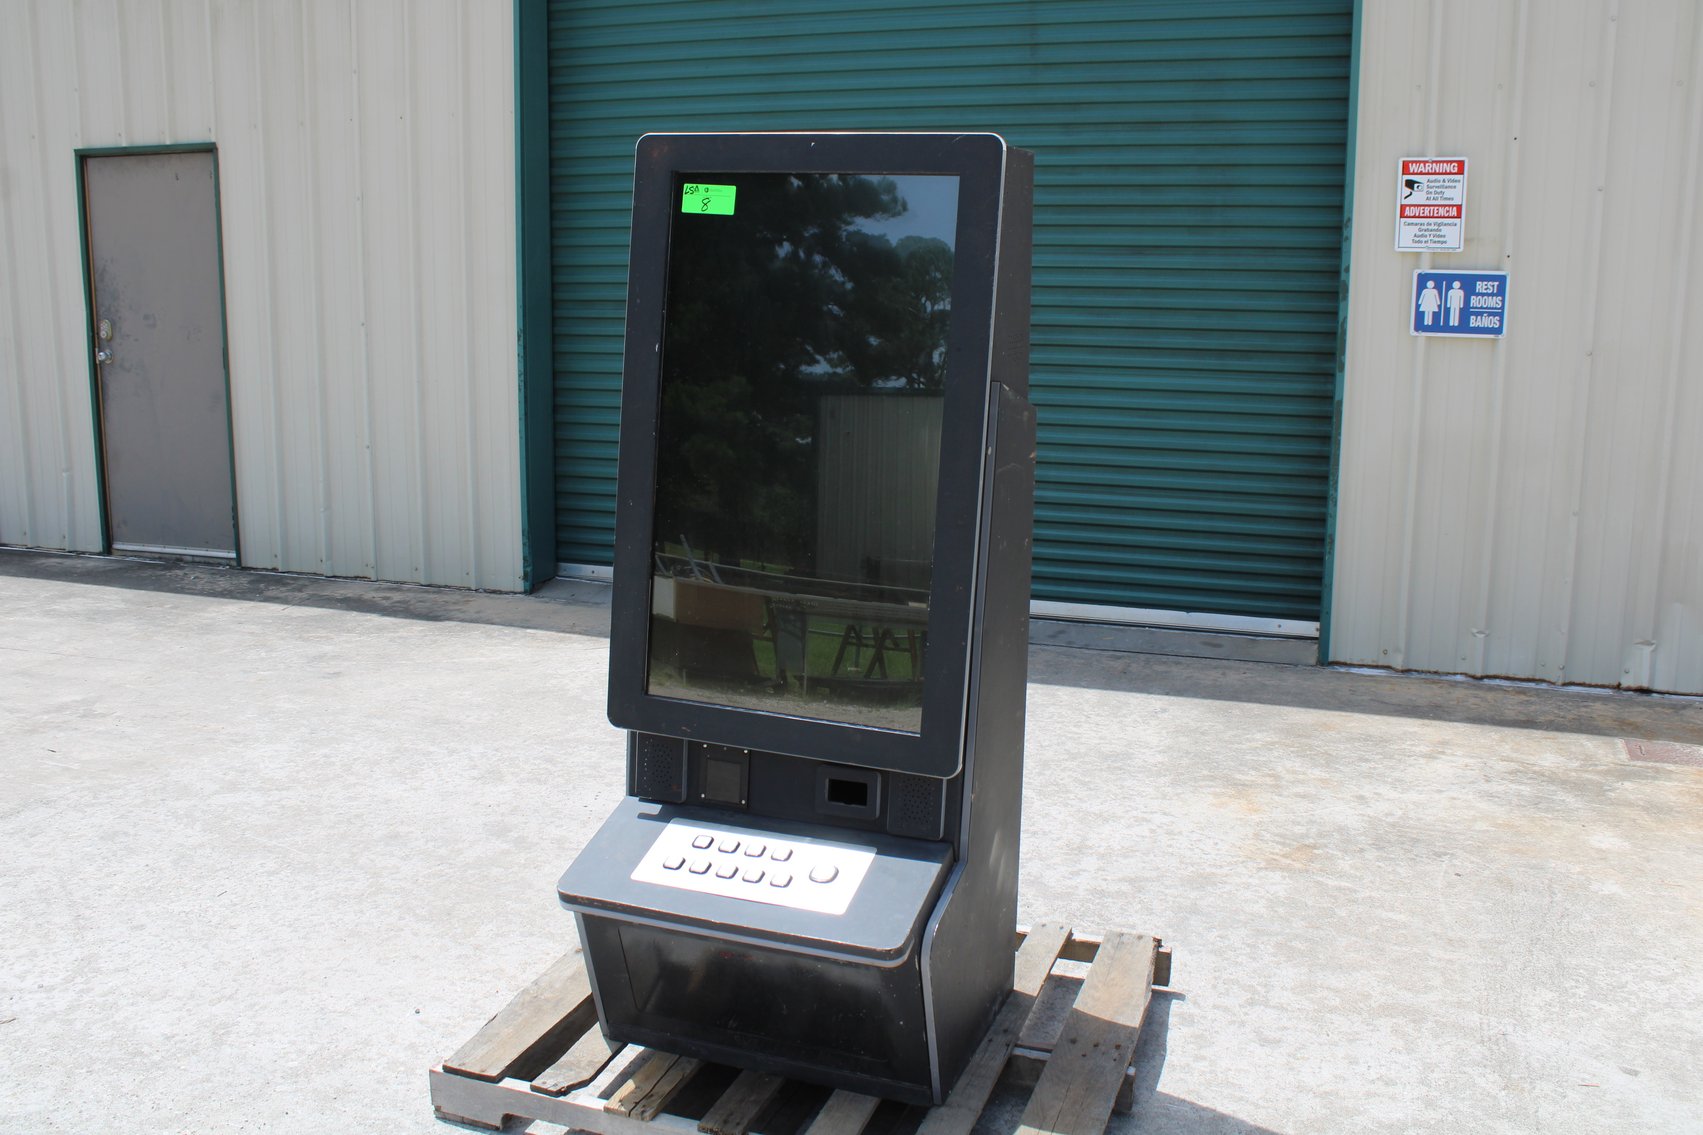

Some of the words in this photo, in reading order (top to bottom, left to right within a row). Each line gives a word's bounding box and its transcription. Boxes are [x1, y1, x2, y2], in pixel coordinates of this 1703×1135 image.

[1408, 162, 1458, 173] WARNING
[700, 197, 712, 212] 8
[1404, 206, 1457, 216] ADVERTENCIA
[1476, 281, 1499, 294] REST
[1470, 296, 1502, 308] ROOMS
[1469, 314, 1500, 328] BAÑOS
